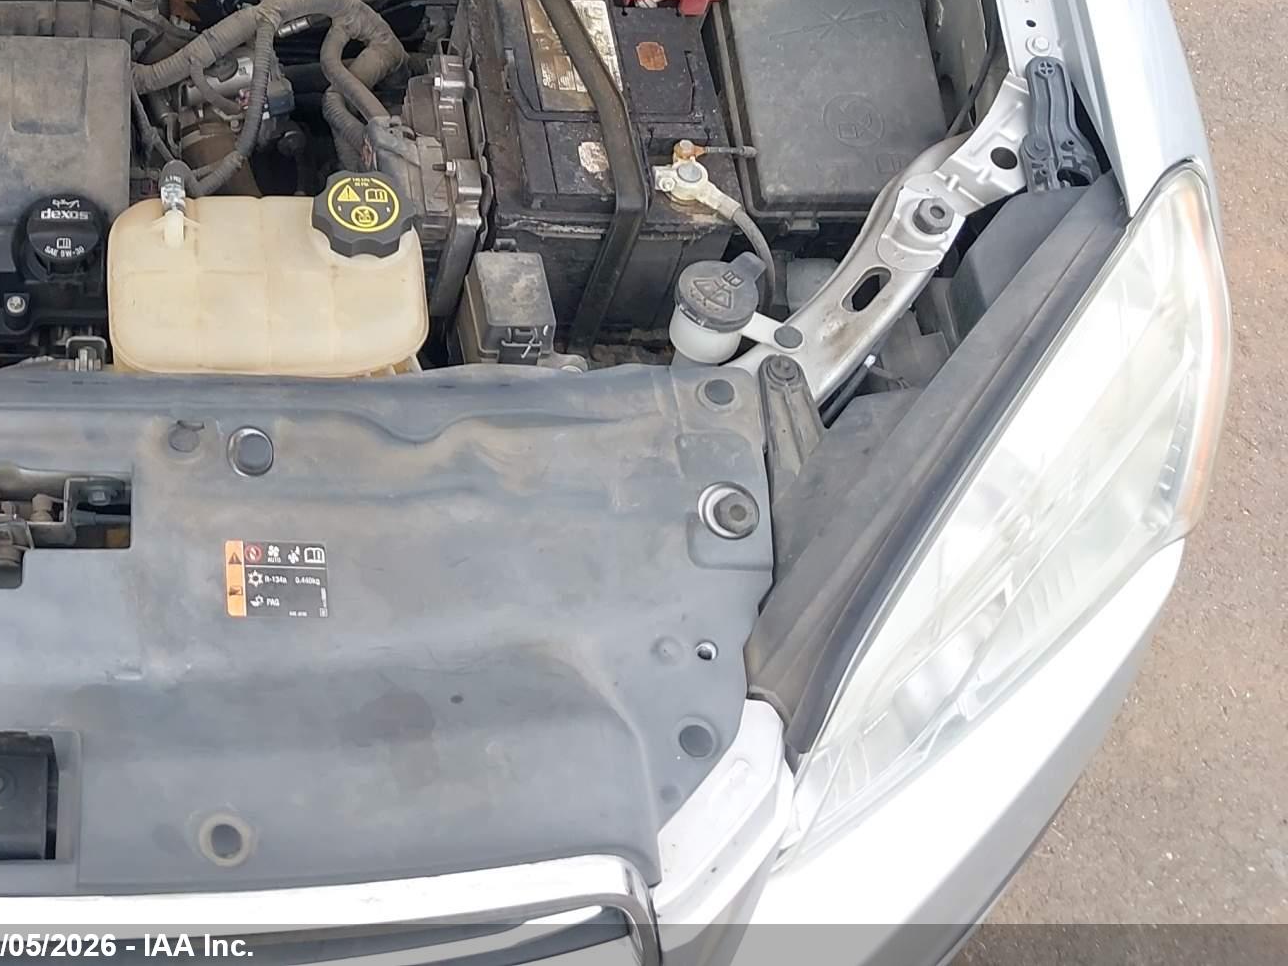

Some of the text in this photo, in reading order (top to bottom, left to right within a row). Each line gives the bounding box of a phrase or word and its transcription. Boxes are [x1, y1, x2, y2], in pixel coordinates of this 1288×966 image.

[40, 208, 89, 220] dexos
[44, 245, 59, 257] SAE
[264, 575, 288, 584] R-134a
